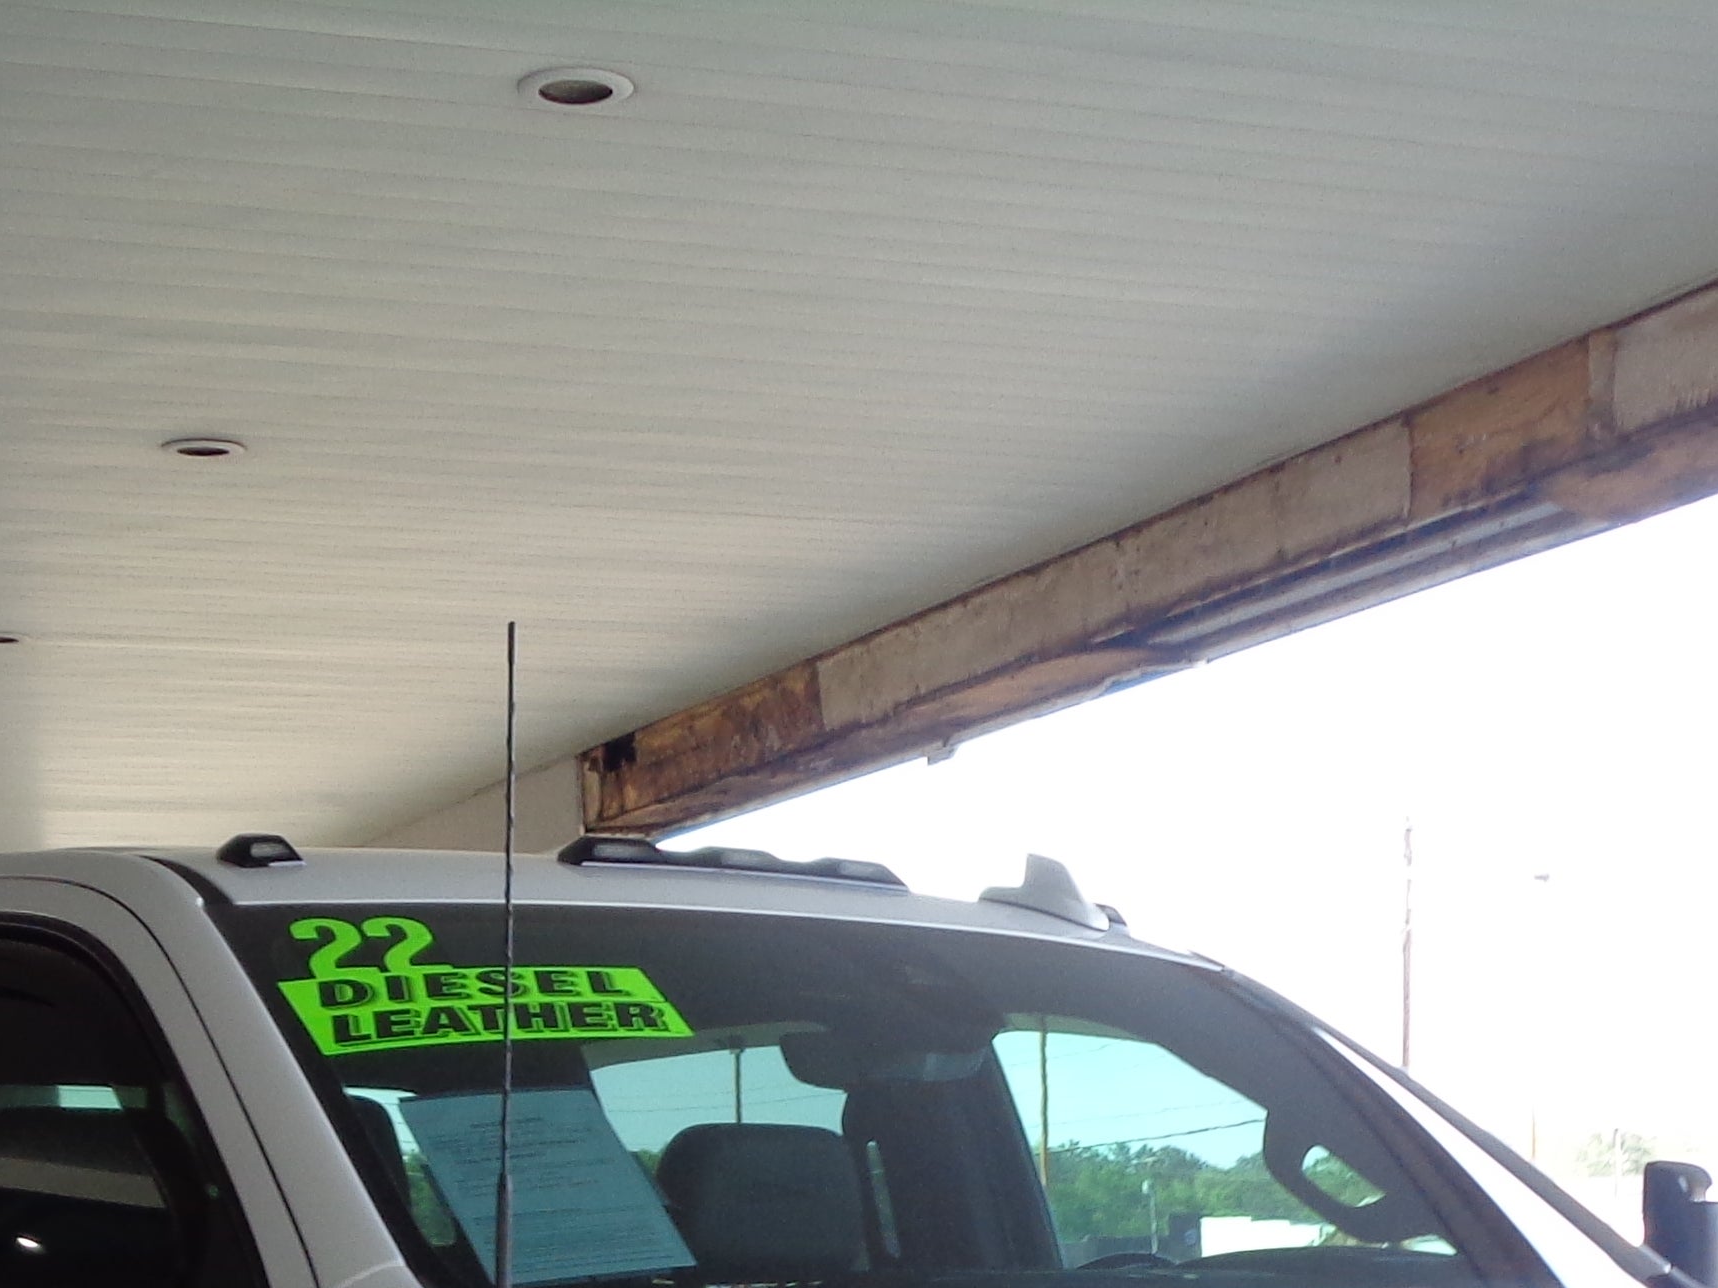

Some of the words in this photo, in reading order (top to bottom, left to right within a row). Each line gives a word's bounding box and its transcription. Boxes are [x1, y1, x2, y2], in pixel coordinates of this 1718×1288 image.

[290, 917, 454, 974] 22
[317, 967, 629, 1009] DIESEL
[331, 1002, 670, 1045] LEATHER
